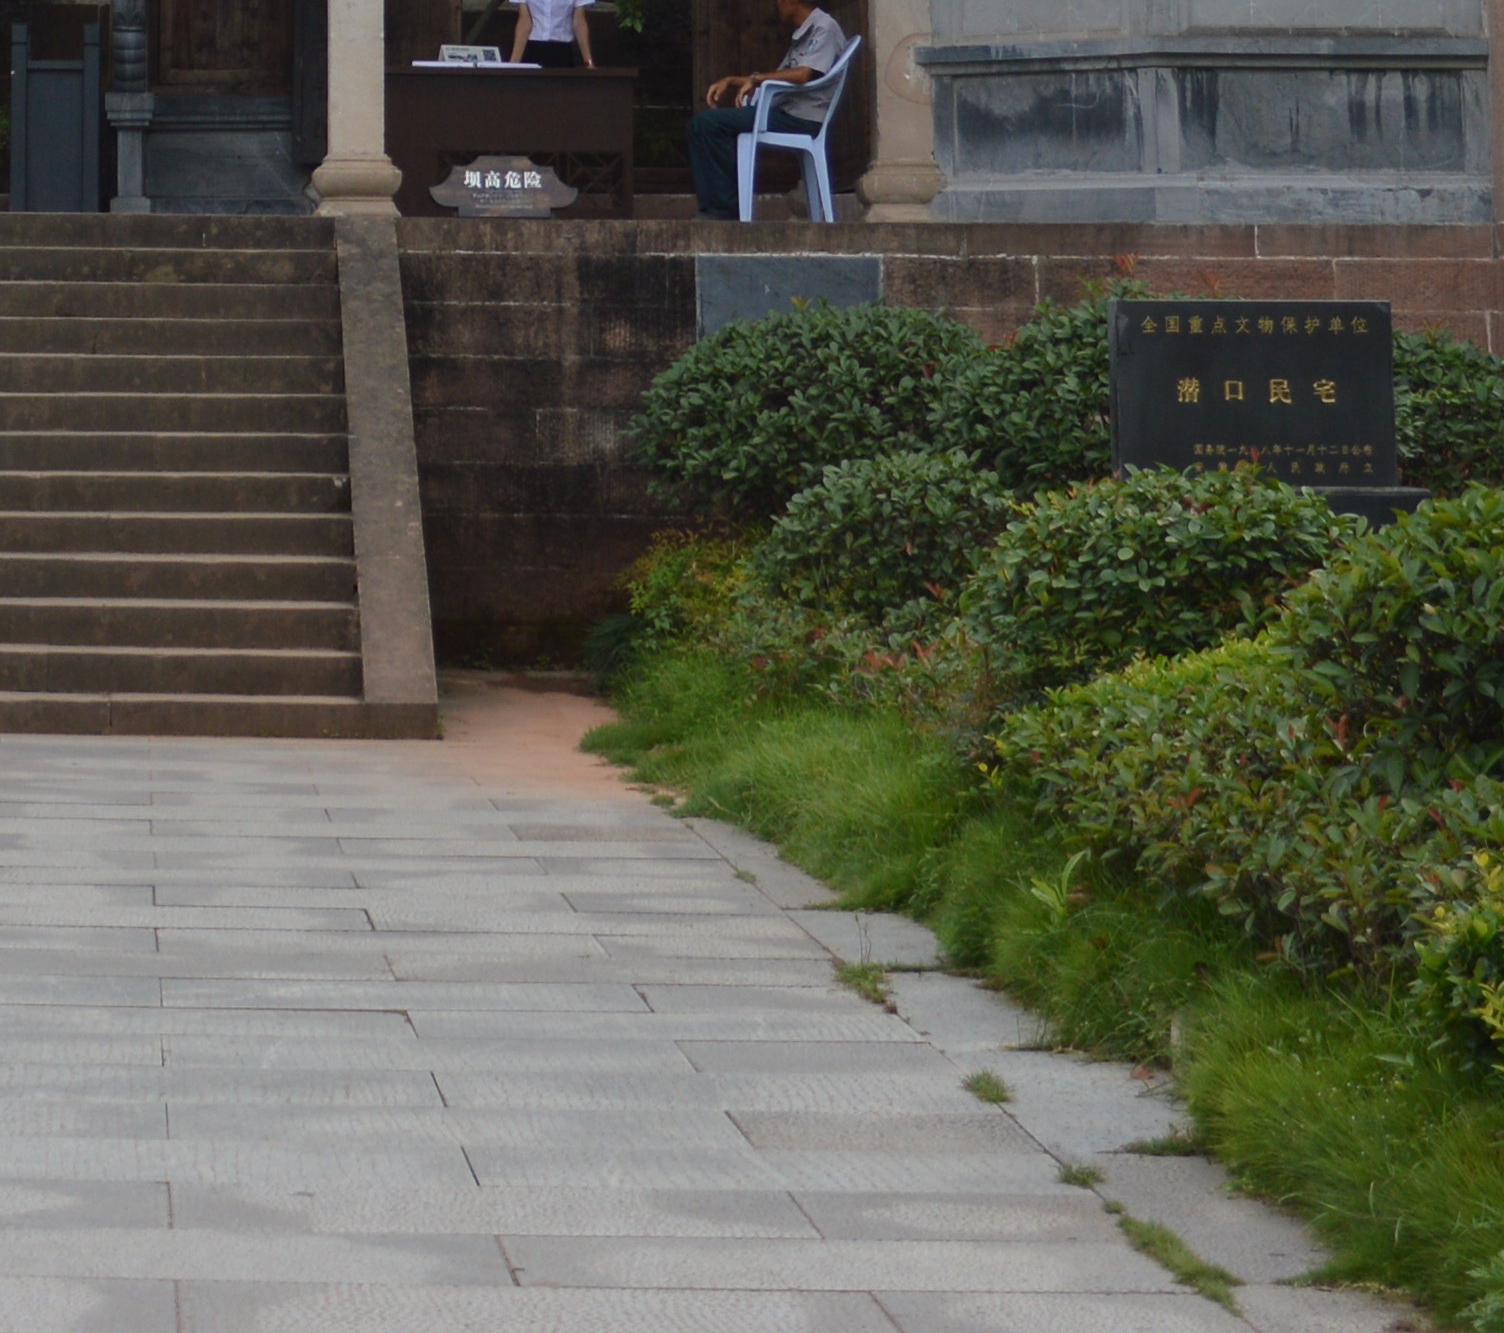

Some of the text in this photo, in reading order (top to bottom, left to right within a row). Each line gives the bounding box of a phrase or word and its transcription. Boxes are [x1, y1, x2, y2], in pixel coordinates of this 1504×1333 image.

[1140, 315, 1369, 336] 全国重点文物保护单位
[1176, 376, 1338, 405] 潜口民宅
